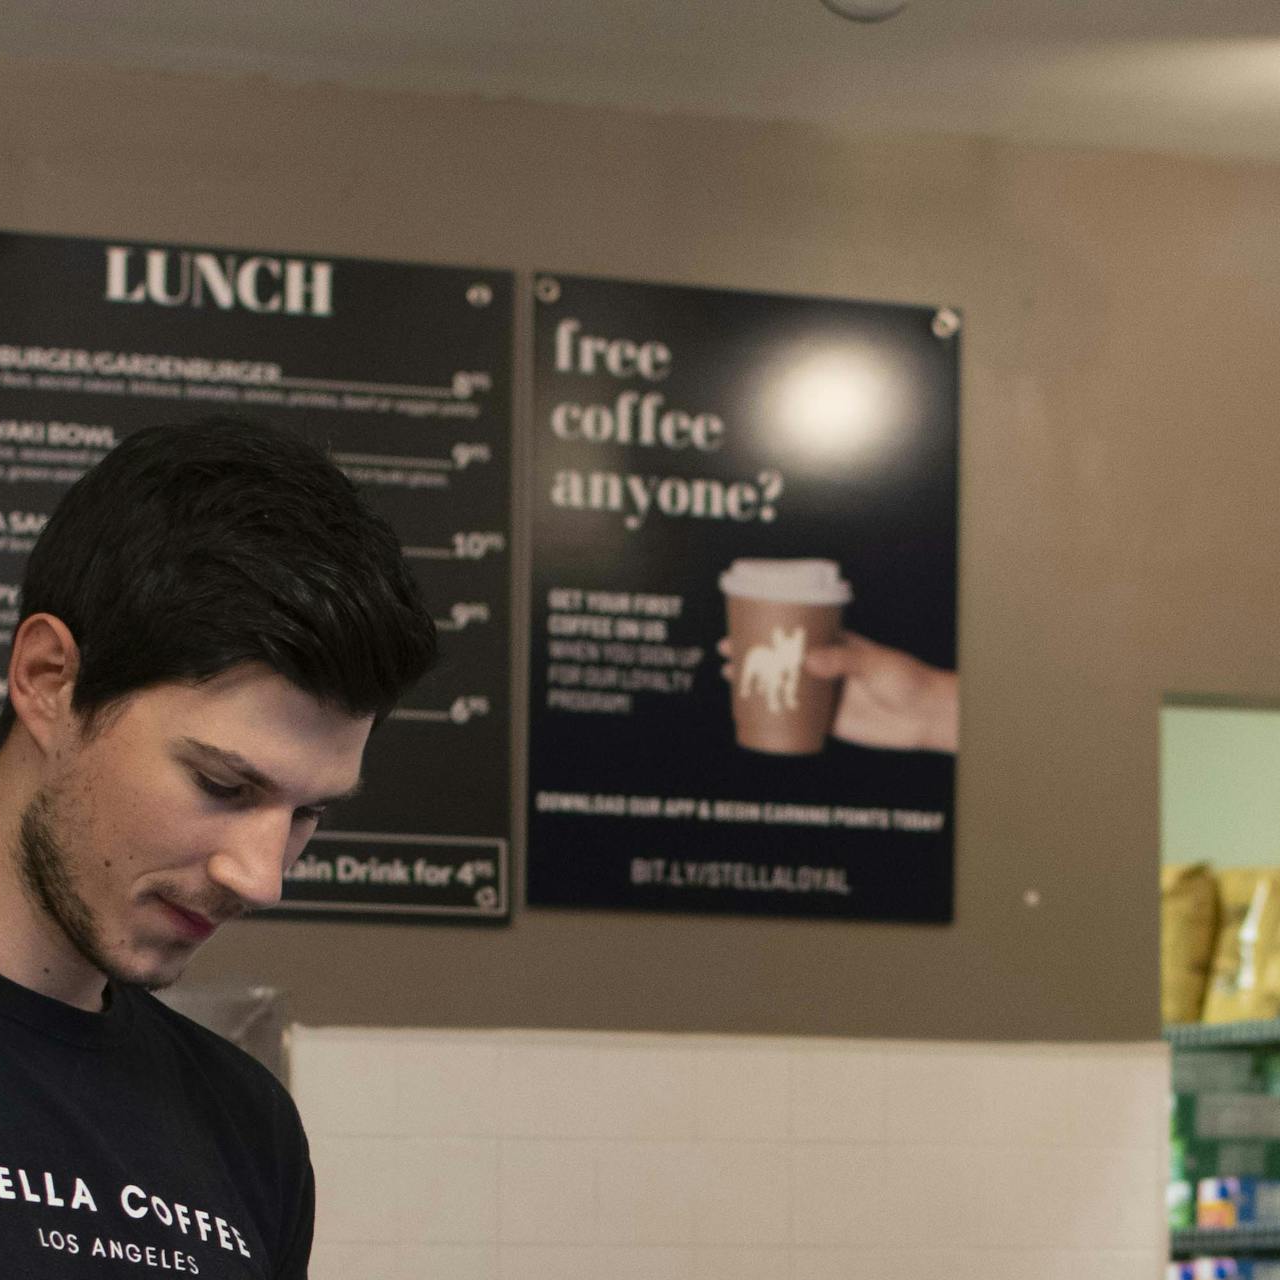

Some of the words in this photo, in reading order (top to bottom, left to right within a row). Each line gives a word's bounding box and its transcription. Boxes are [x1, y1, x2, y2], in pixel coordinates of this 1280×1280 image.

[105, 245, 333, 317] LUNCH
[554, 317, 672, 380] free
[46, 421, 115, 449] BOWL
[551, 389, 725, 452] coffee
[551, 467, 785, 531] anyone?
[336, 855, 409, 884] Drink
[414, 858, 453, 885] for
[38, 1228, 80, 1254] LOS
[92, 1238, 200, 1275] ANGELES
[120, 1184, 251, 1258] COFFEE
